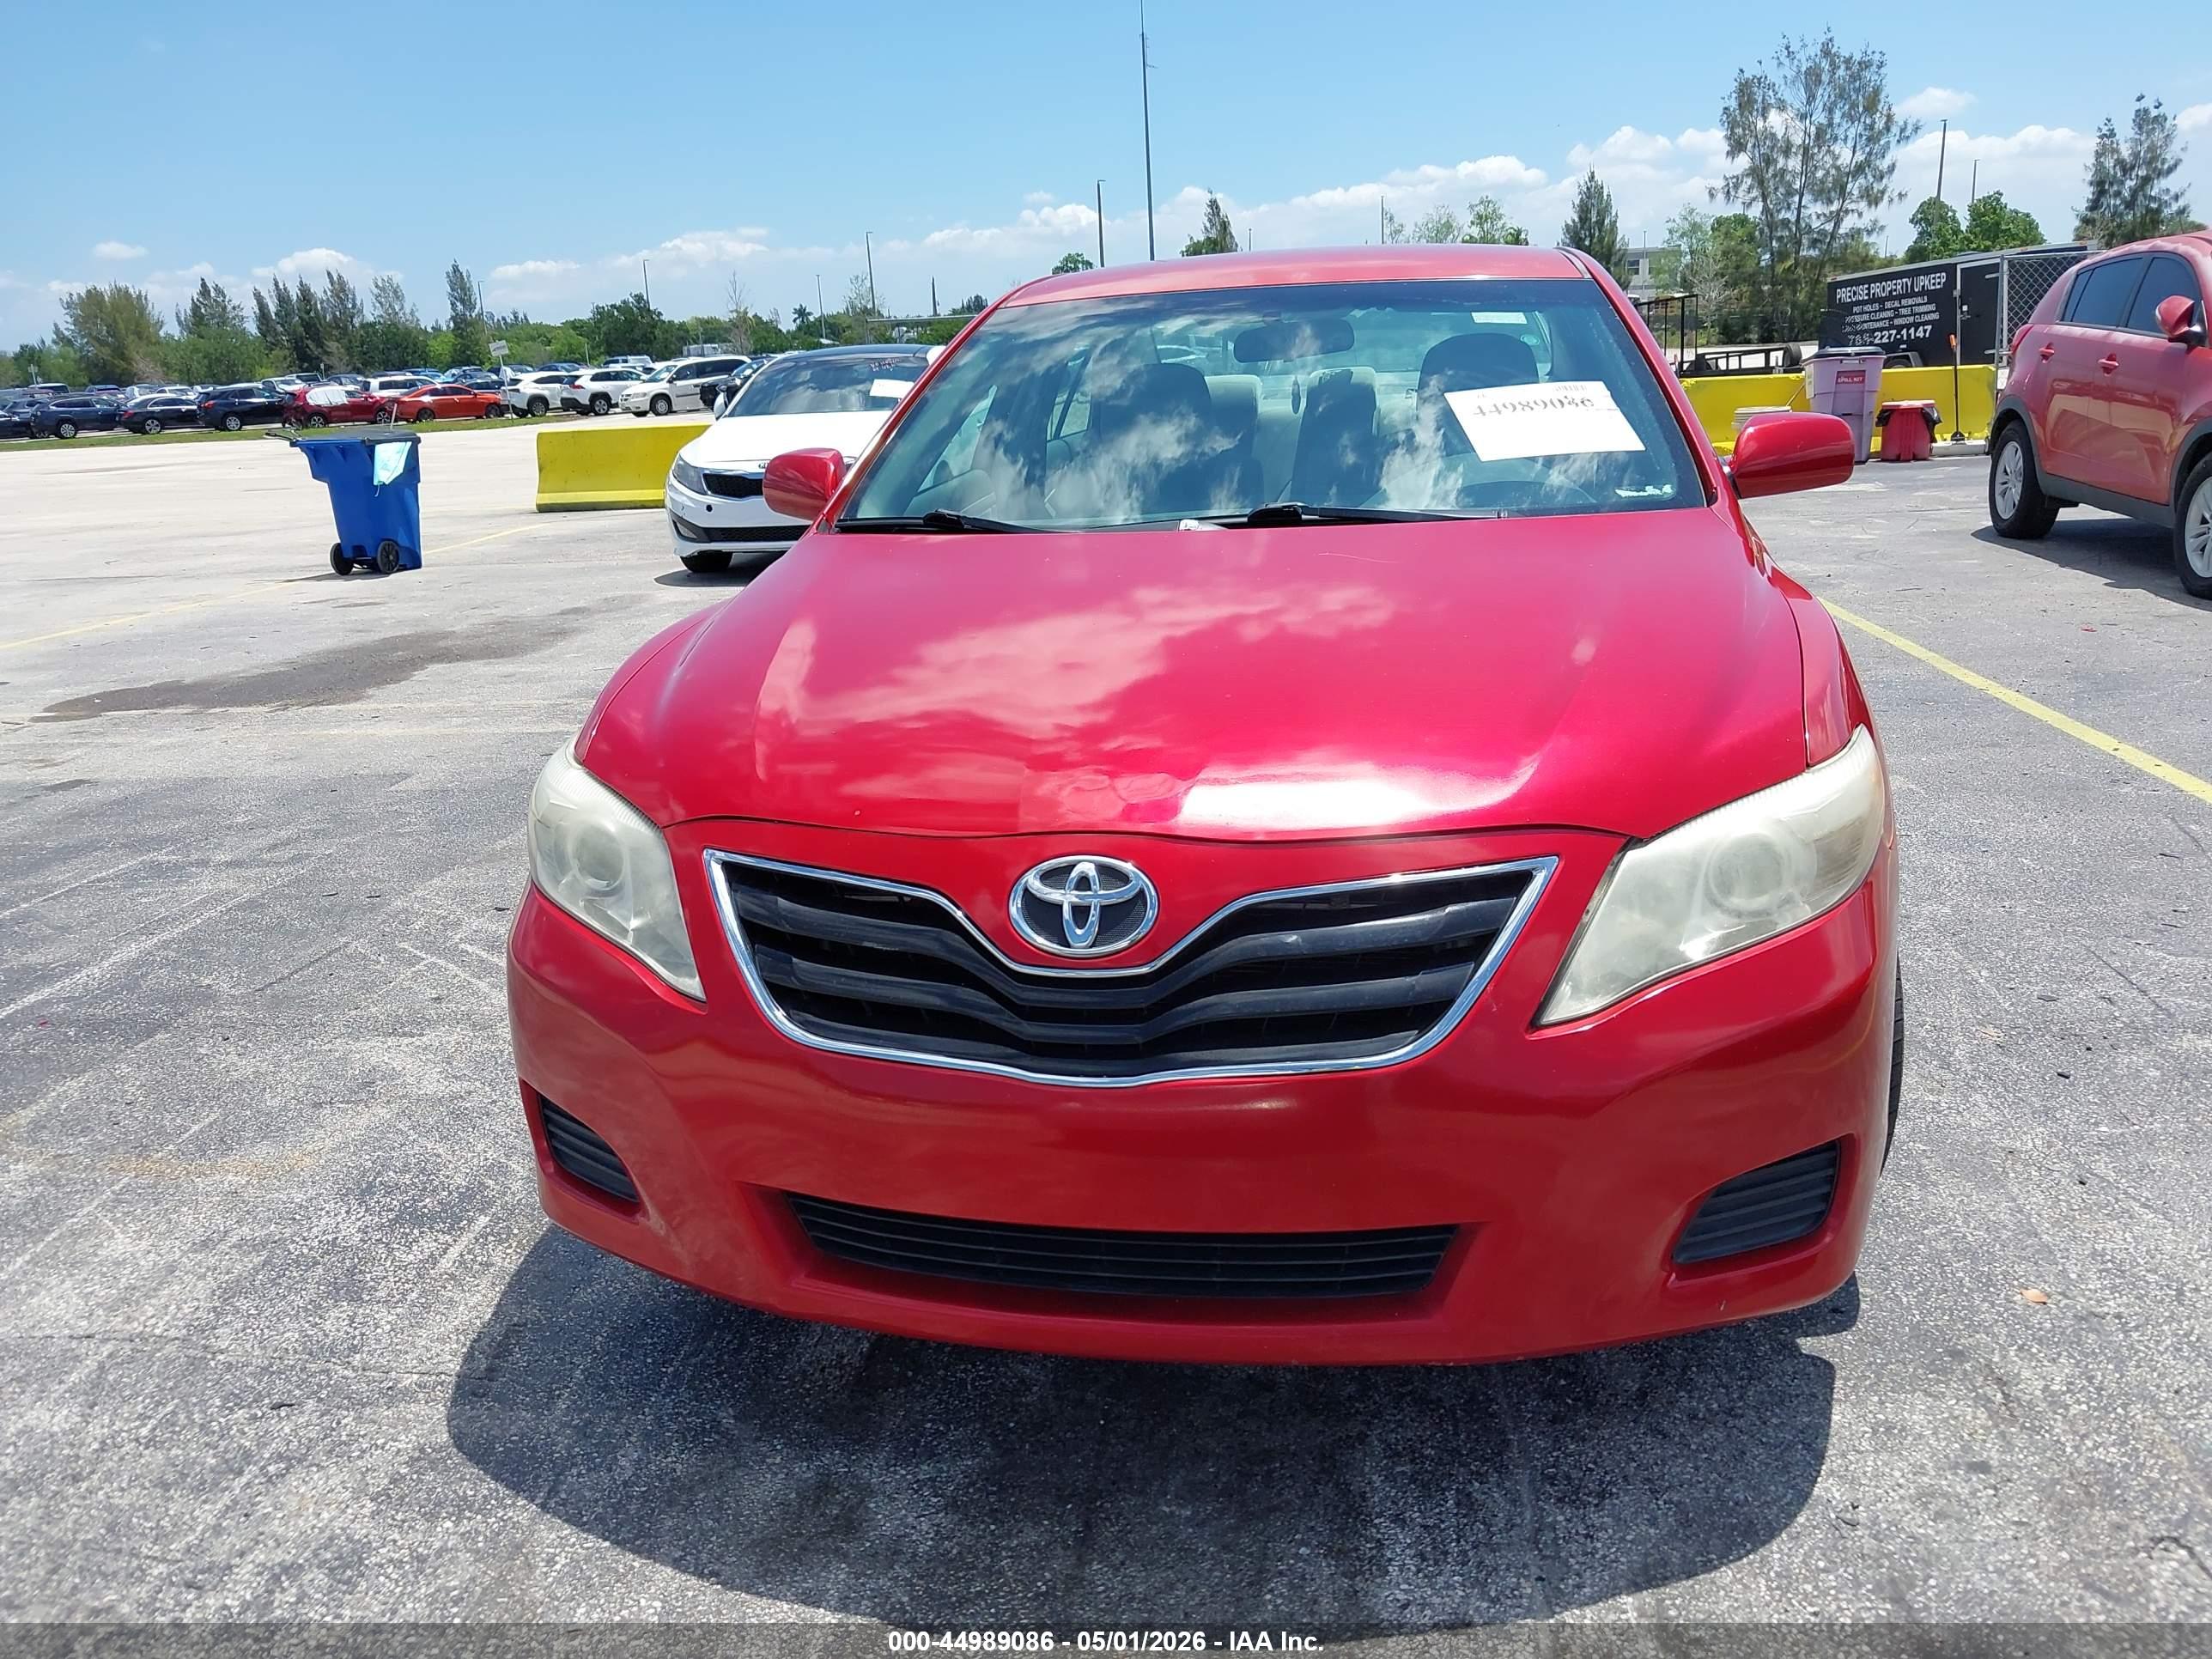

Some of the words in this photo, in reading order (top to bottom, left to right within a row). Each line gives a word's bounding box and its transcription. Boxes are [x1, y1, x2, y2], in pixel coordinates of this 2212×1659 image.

[1836, 286, 1869, 303] PRECISE
[1869, 276, 1912, 299] PROPERTY
[1914, 271, 1947, 293] UPKEEP
[1853, 305, 1863, 313] POT
[1884, 301, 1900, 309] DECAL
[1900, 295, 1928, 306] REMOVALS
[1870, 308, 1894, 319] CLEANING
[1912, 303, 1936, 313] TRIMMING
[1893, 316, 1914, 326] WINDOW
[1915, 312, 1940, 324] CLEANING
